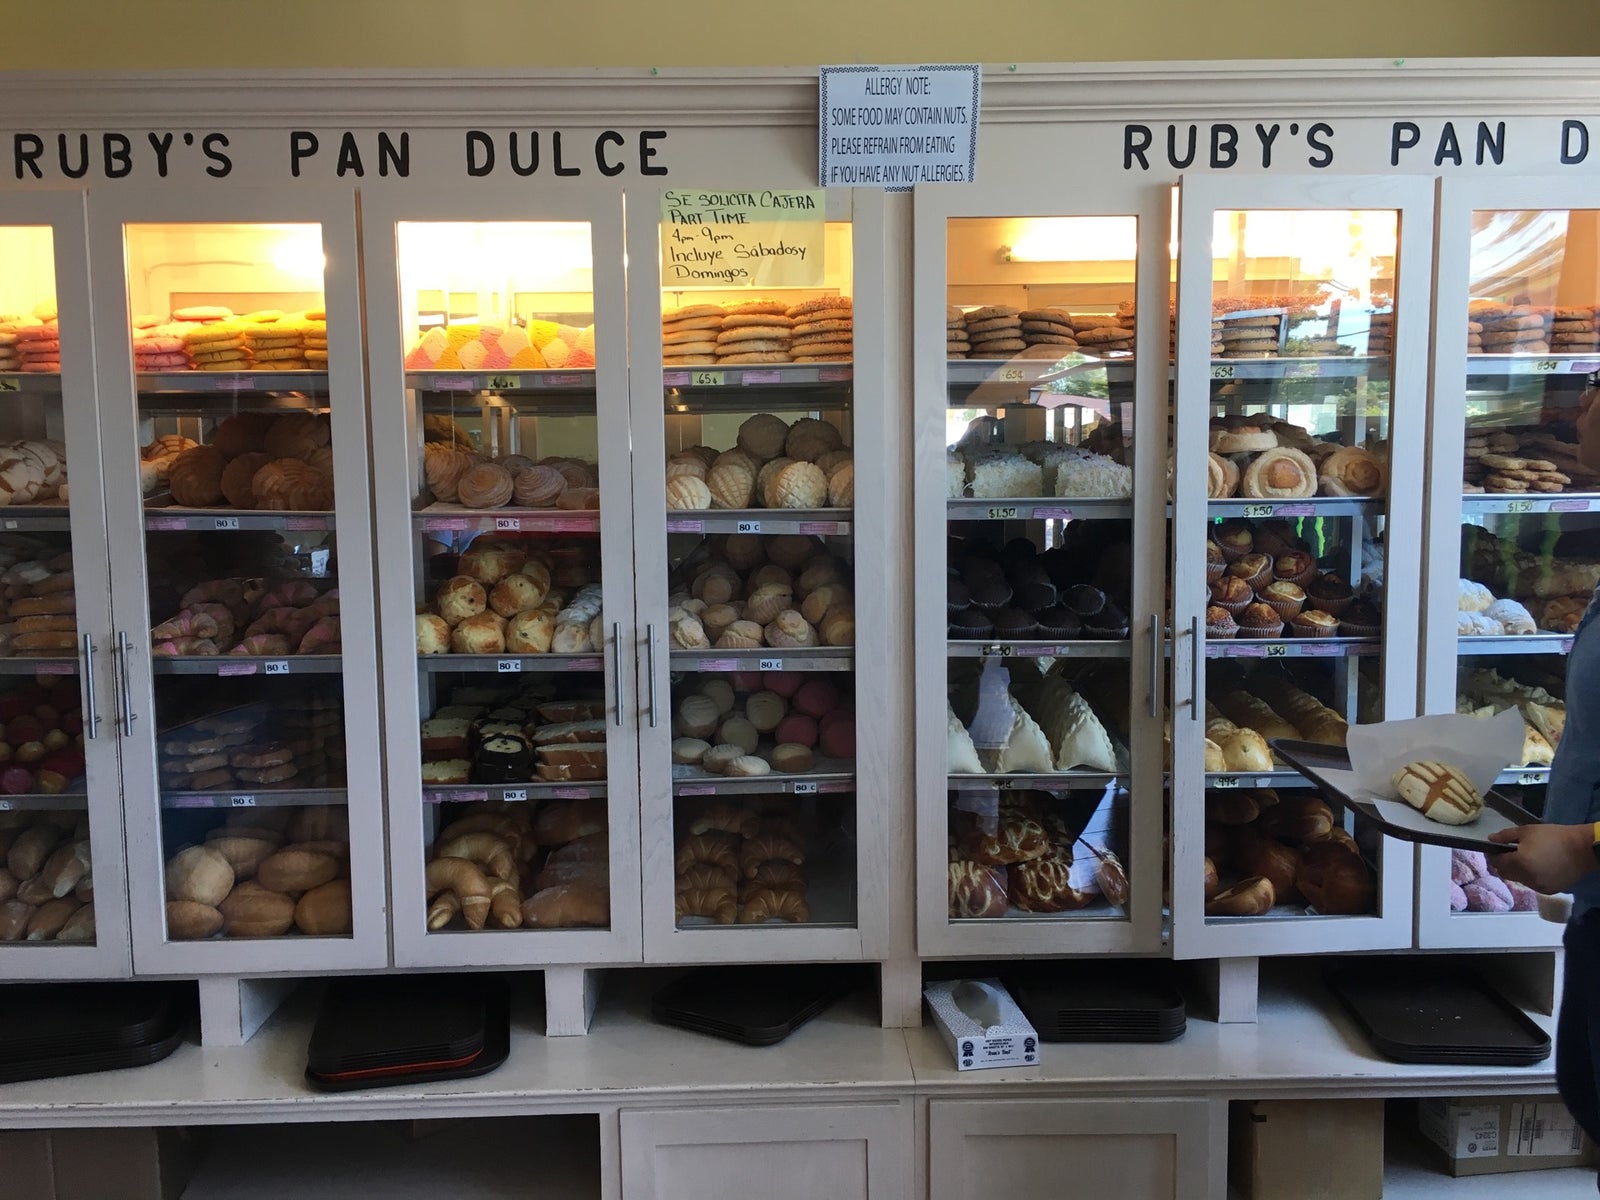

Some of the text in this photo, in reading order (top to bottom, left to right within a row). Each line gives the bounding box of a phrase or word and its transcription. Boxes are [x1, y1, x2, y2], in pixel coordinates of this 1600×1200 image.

[864, 76, 931, 96] ALLERGY NOTE:
[832, 106, 968, 126] SOME FOOD MAY CONTAIN NUTS.
[14, 129, 670, 180] RUBY'S PAN DULCE
[831, 136, 956, 155] PLEASE REFRAIN FROM EATING
[1123, 121, 1335, 171] RUBY'S
[1390, 120, 1507, 168] PAN
[831, 164, 965, 183] IF YOU HAVE ANY NUT ALLERGIES.
[665, 190, 816, 210] SE SOLICITA CAJERA
[668, 208, 750, 225] PART TIME
[670, 246, 724, 265] Incluye
[669, 264, 749, 283] Domingos
[216, 519, 228, 527] 80
[498, 520, 509, 528] 80
[266, 664, 278, 672] 80
[499, 662, 511, 670] 80
[795, 784, 807, 792] 80
